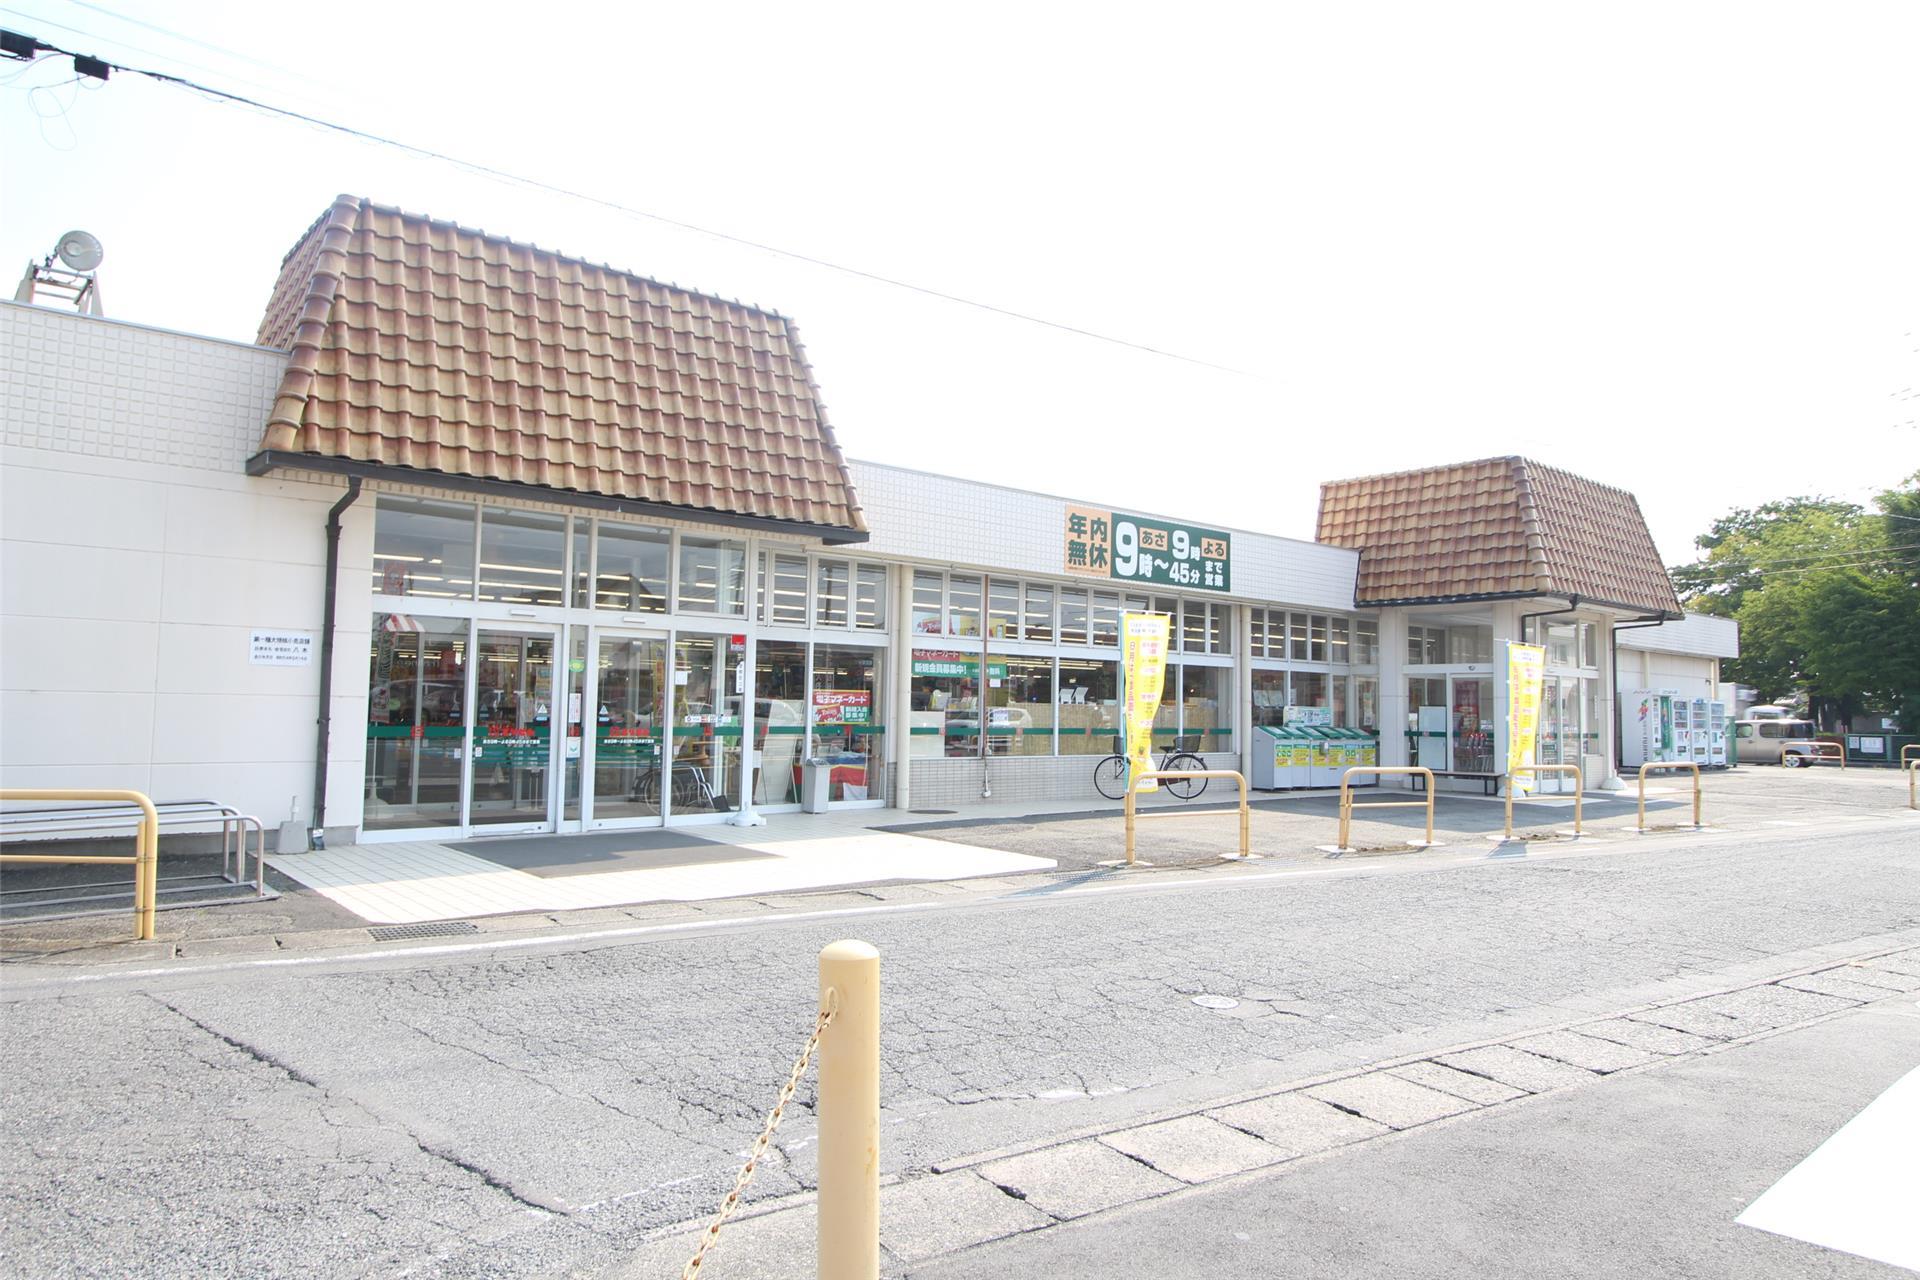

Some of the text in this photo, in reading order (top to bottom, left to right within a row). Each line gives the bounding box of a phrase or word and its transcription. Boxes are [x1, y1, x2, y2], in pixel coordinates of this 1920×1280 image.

[1068, 513, 1108, 543] 年内
[1142, 530, 1164, 547] あさ
[1068, 539, 1108, 568] 無休
[1203, 541, 1224, 557] よる
[1169, 562, 1200, 585] 45分
[1204, 560, 1223, 574] まで
[1204, 573, 1224, 587] 営業
